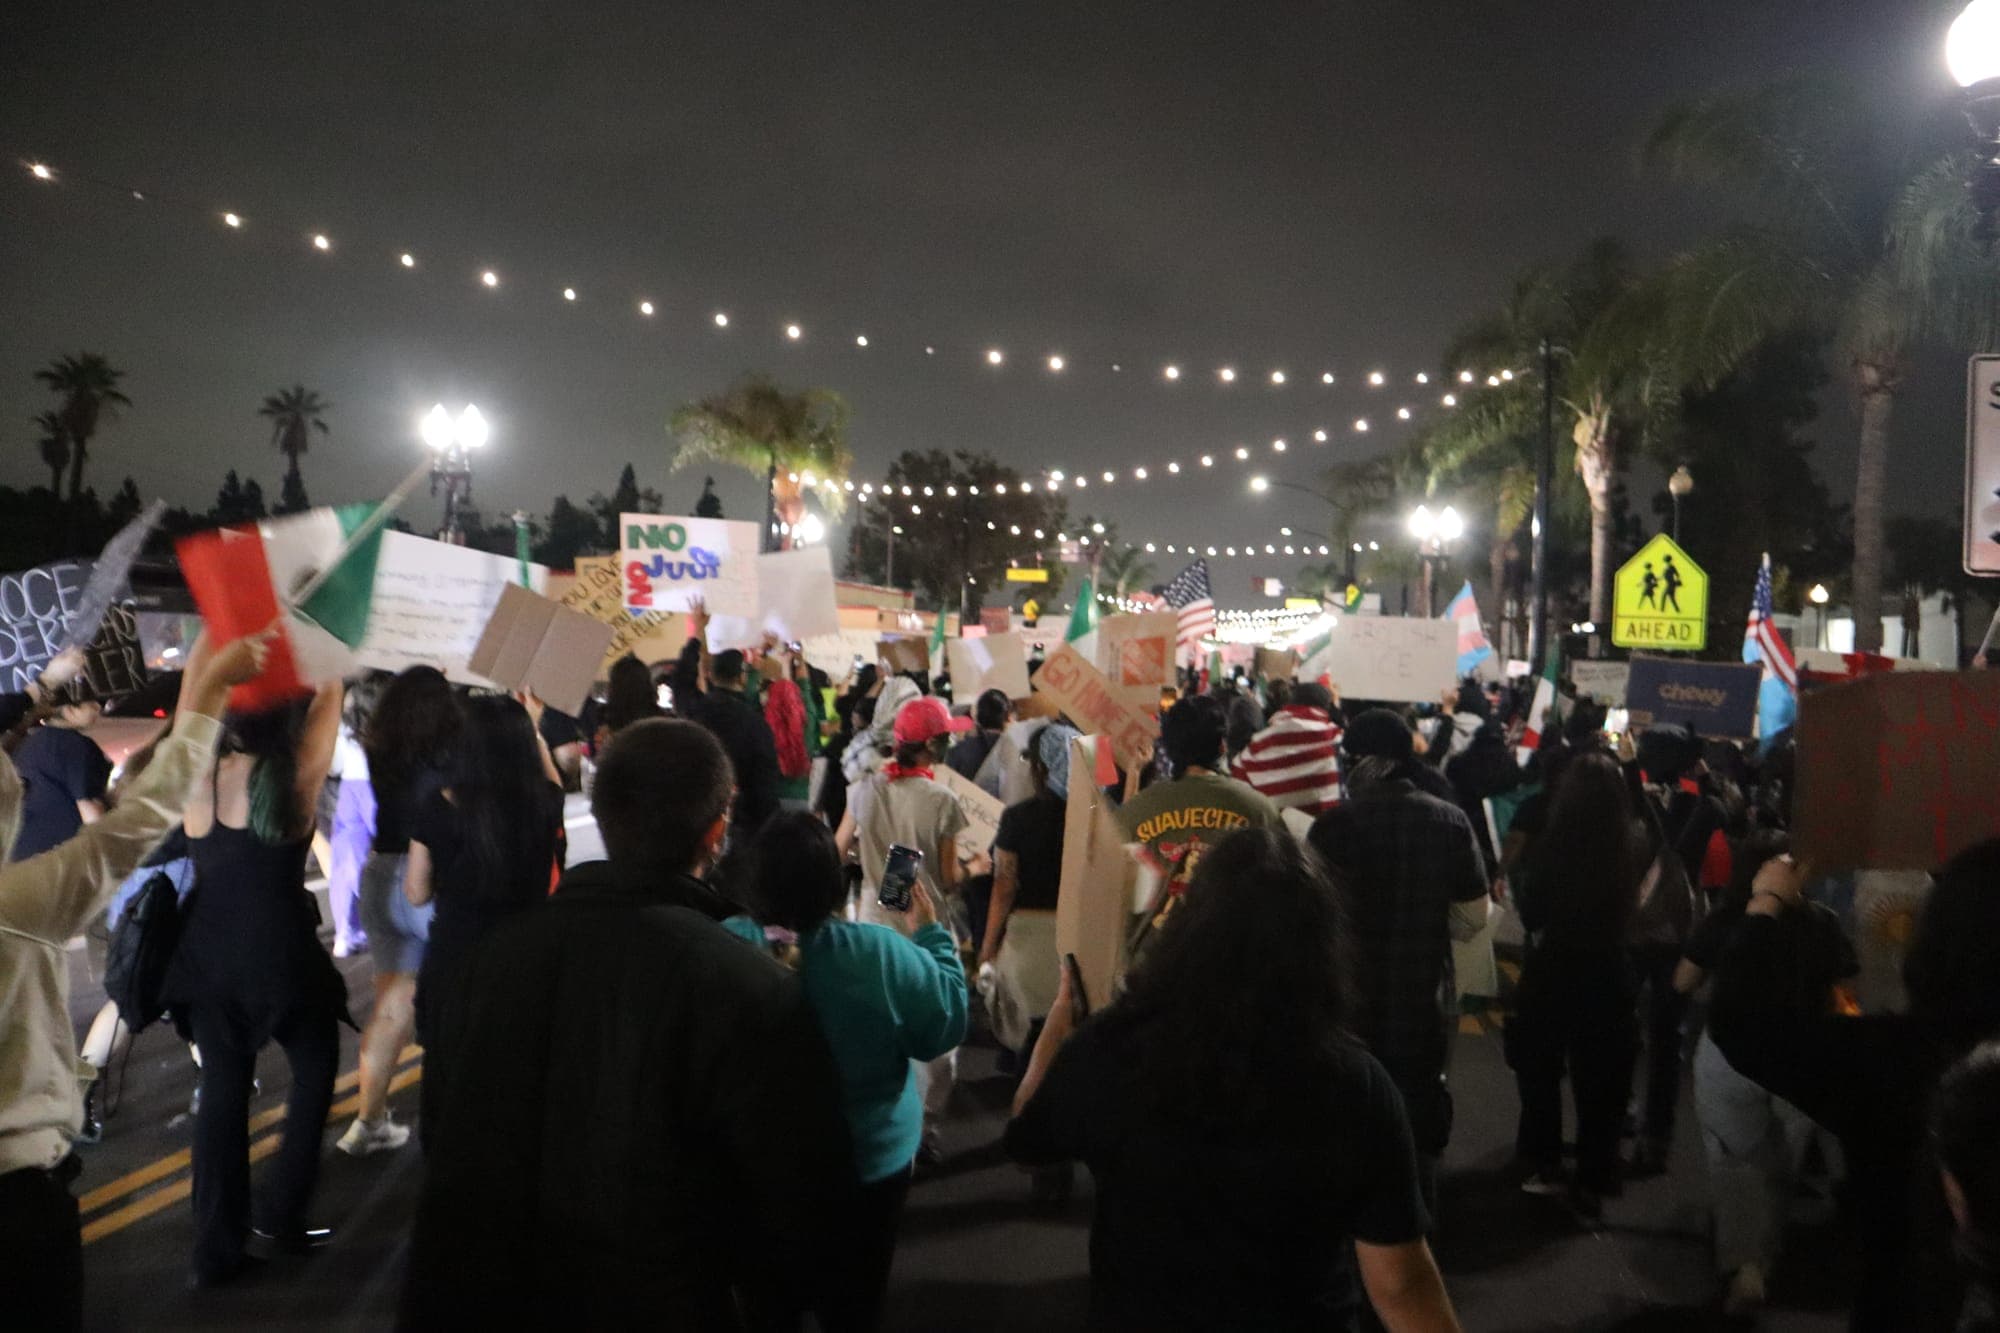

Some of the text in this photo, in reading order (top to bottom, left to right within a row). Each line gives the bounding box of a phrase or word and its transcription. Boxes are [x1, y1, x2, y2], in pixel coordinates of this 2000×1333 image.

[626, 524, 687, 551] NO
[626, 560, 653, 606] NO
[1626, 621, 1692, 641] AHEAD
